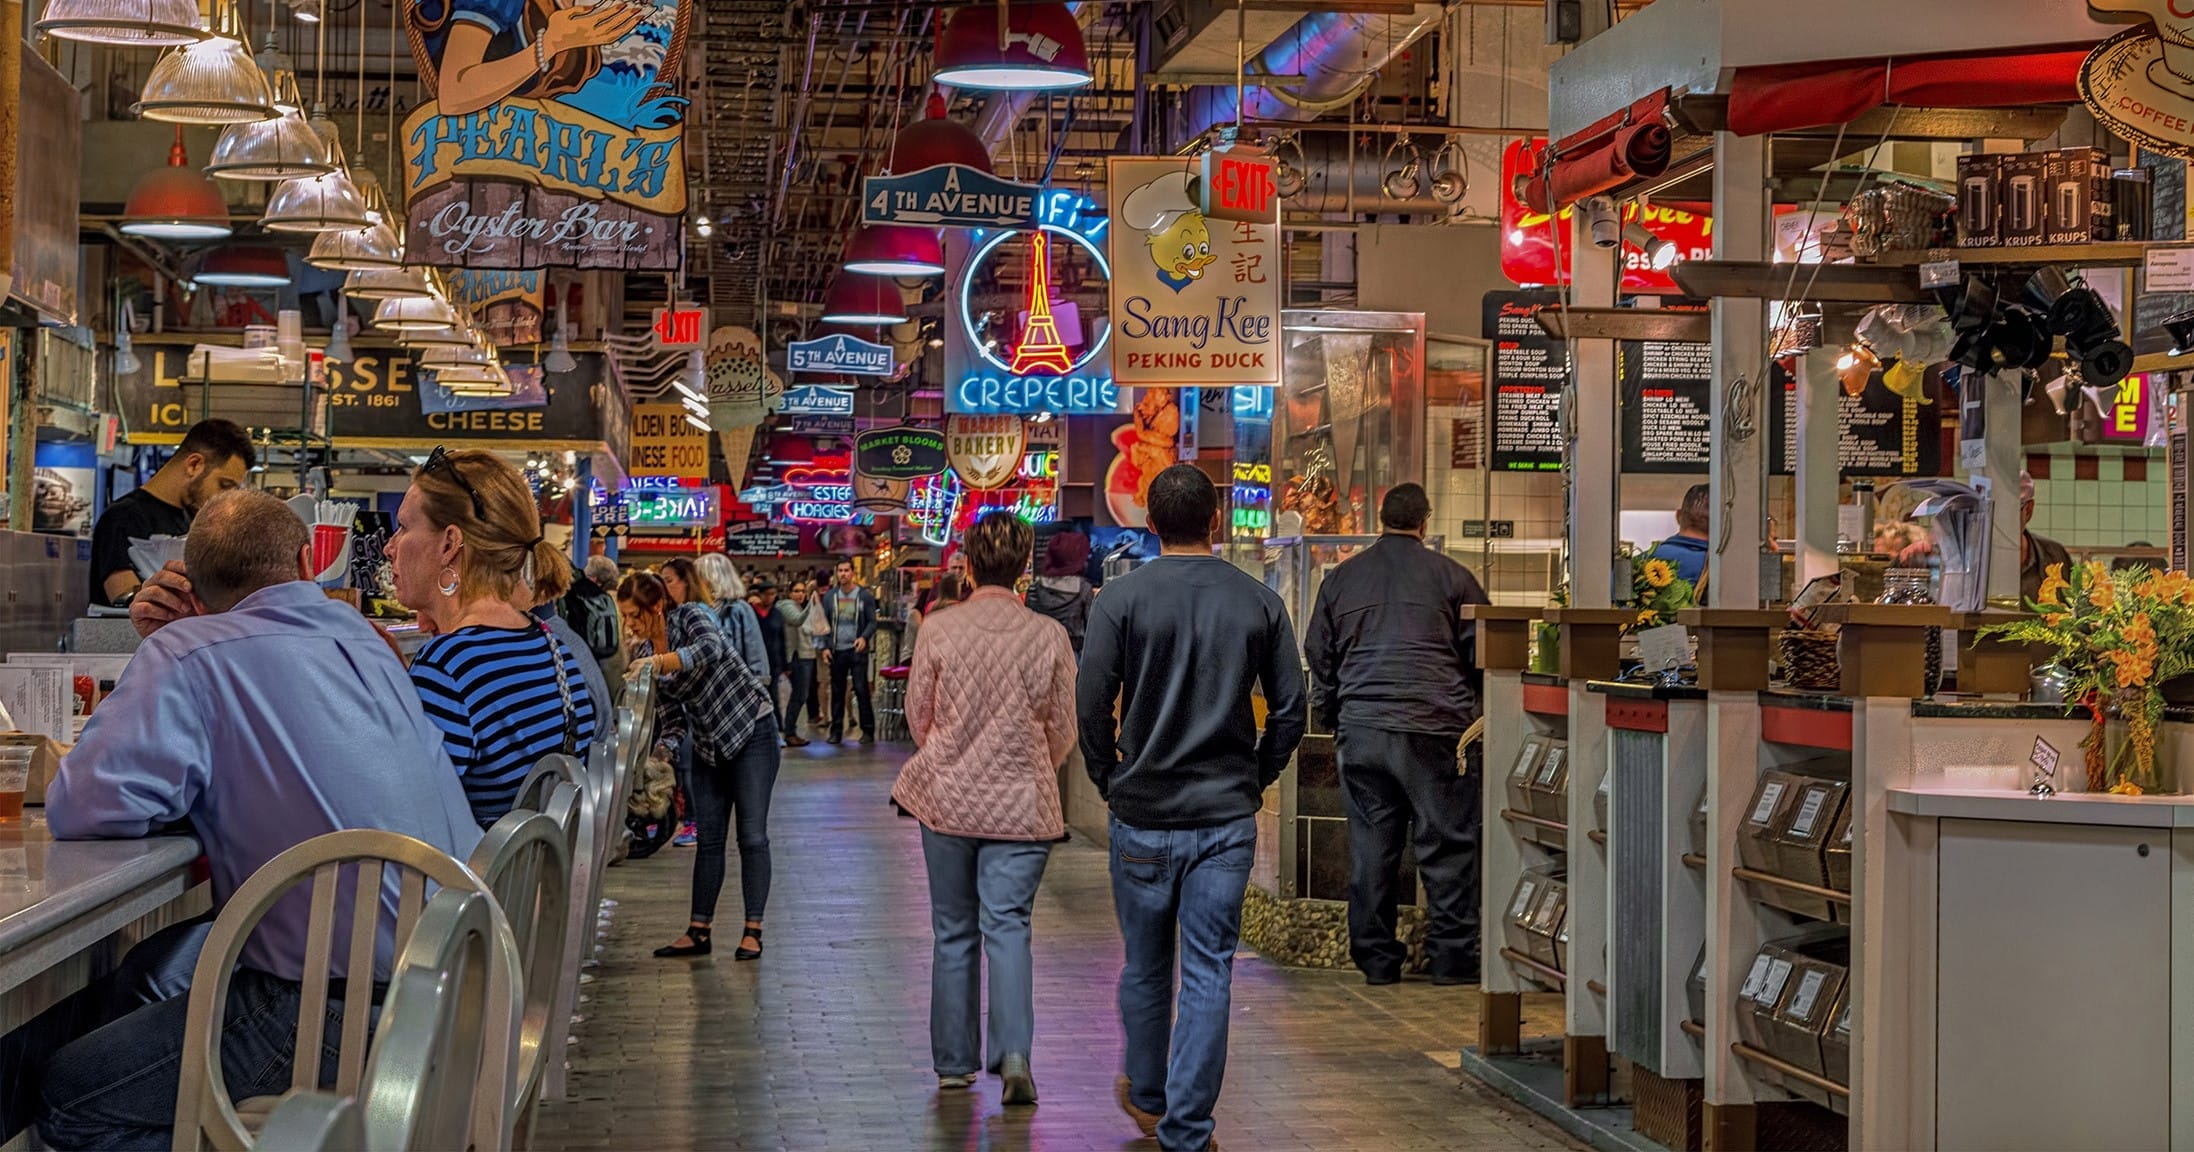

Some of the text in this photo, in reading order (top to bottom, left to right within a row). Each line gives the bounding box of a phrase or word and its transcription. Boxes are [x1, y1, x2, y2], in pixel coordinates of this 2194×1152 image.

[2120, 96, 2187, 132] COFFEE
[411, 104, 681, 198] PEARL'S
[944, 166, 960, 192] A
[1221, 160, 1270, 212] EXIT
[925, 192, 1032, 215] AVENUE
[428, 200, 640, 254] Oyster Bar
[1960, 236, 1997, 247] KRUPS
[2005, 235, 2042, 247] KRUPS
[2050, 231, 2088, 245] KRUPS
[661, 311, 703, 343] EXIT
[1120, 294, 1271, 349] Sang Kee
[825, 351, 888, 365] AVENUE
[1128, 353, 1266, 369] PEKING DUCK
[801, 396, 849, 407] AVENUE
[961, 377, 1118, 408] CREPERIE
[428, 412, 543, 430] CHEESE
[814, 421, 852, 429] AVENUE
[957, 416, 1012, 434] MARKET
[860, 436, 944, 452] MARKET BLOOMS
[953, 435, 1016, 456] BAKERY
[671, 446, 704, 468] FOOD
[793, 502, 850, 519] HOAGIES
